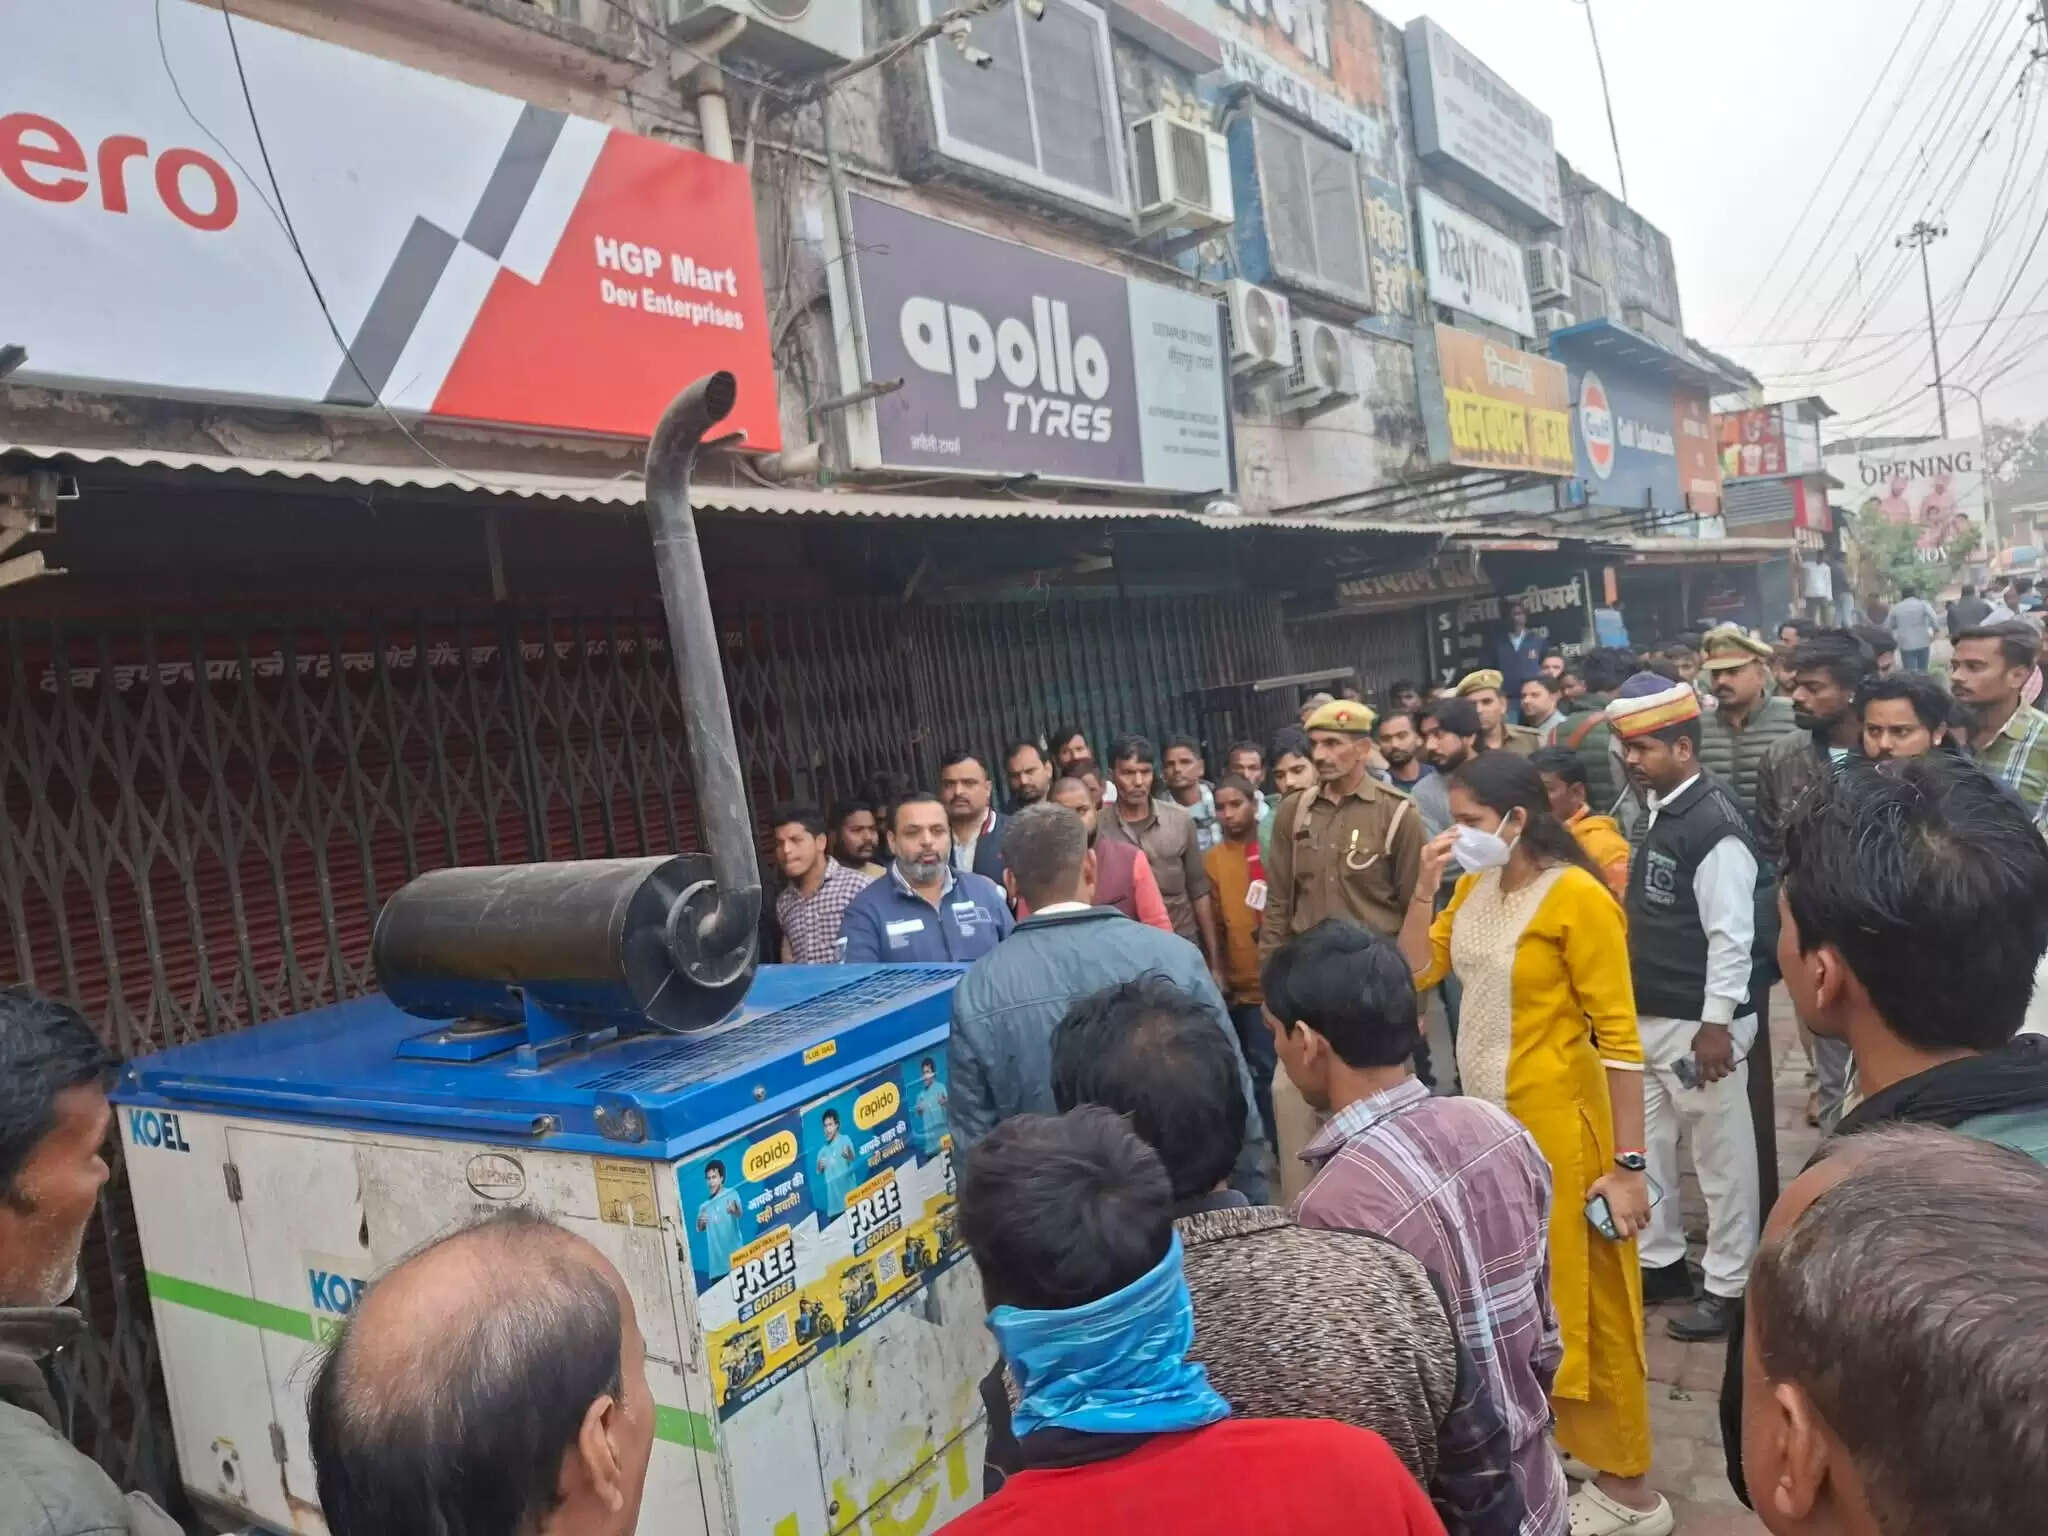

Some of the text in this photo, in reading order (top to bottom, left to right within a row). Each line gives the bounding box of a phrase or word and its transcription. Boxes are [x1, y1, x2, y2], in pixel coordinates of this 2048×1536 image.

[595, 234, 737, 297] HGP Mart
[601, 278, 744, 330] Dev Enterprises
[901, 296, 1110, 409] apollo
[1003, 391, 1112, 443] TYRES
[1860, 451, 1972, 487] OPENING
[860, 1091, 894, 1120] rapido
[128, 1108, 191, 1153] KOEL
[750, 1141, 791, 1172] rapido
[846, 1180, 901, 1239] FREE
[867, 1218, 900, 1247] GOFREE
[730, 1239, 796, 1304] FREE
[753, 1279, 795, 1313] GOFREE
